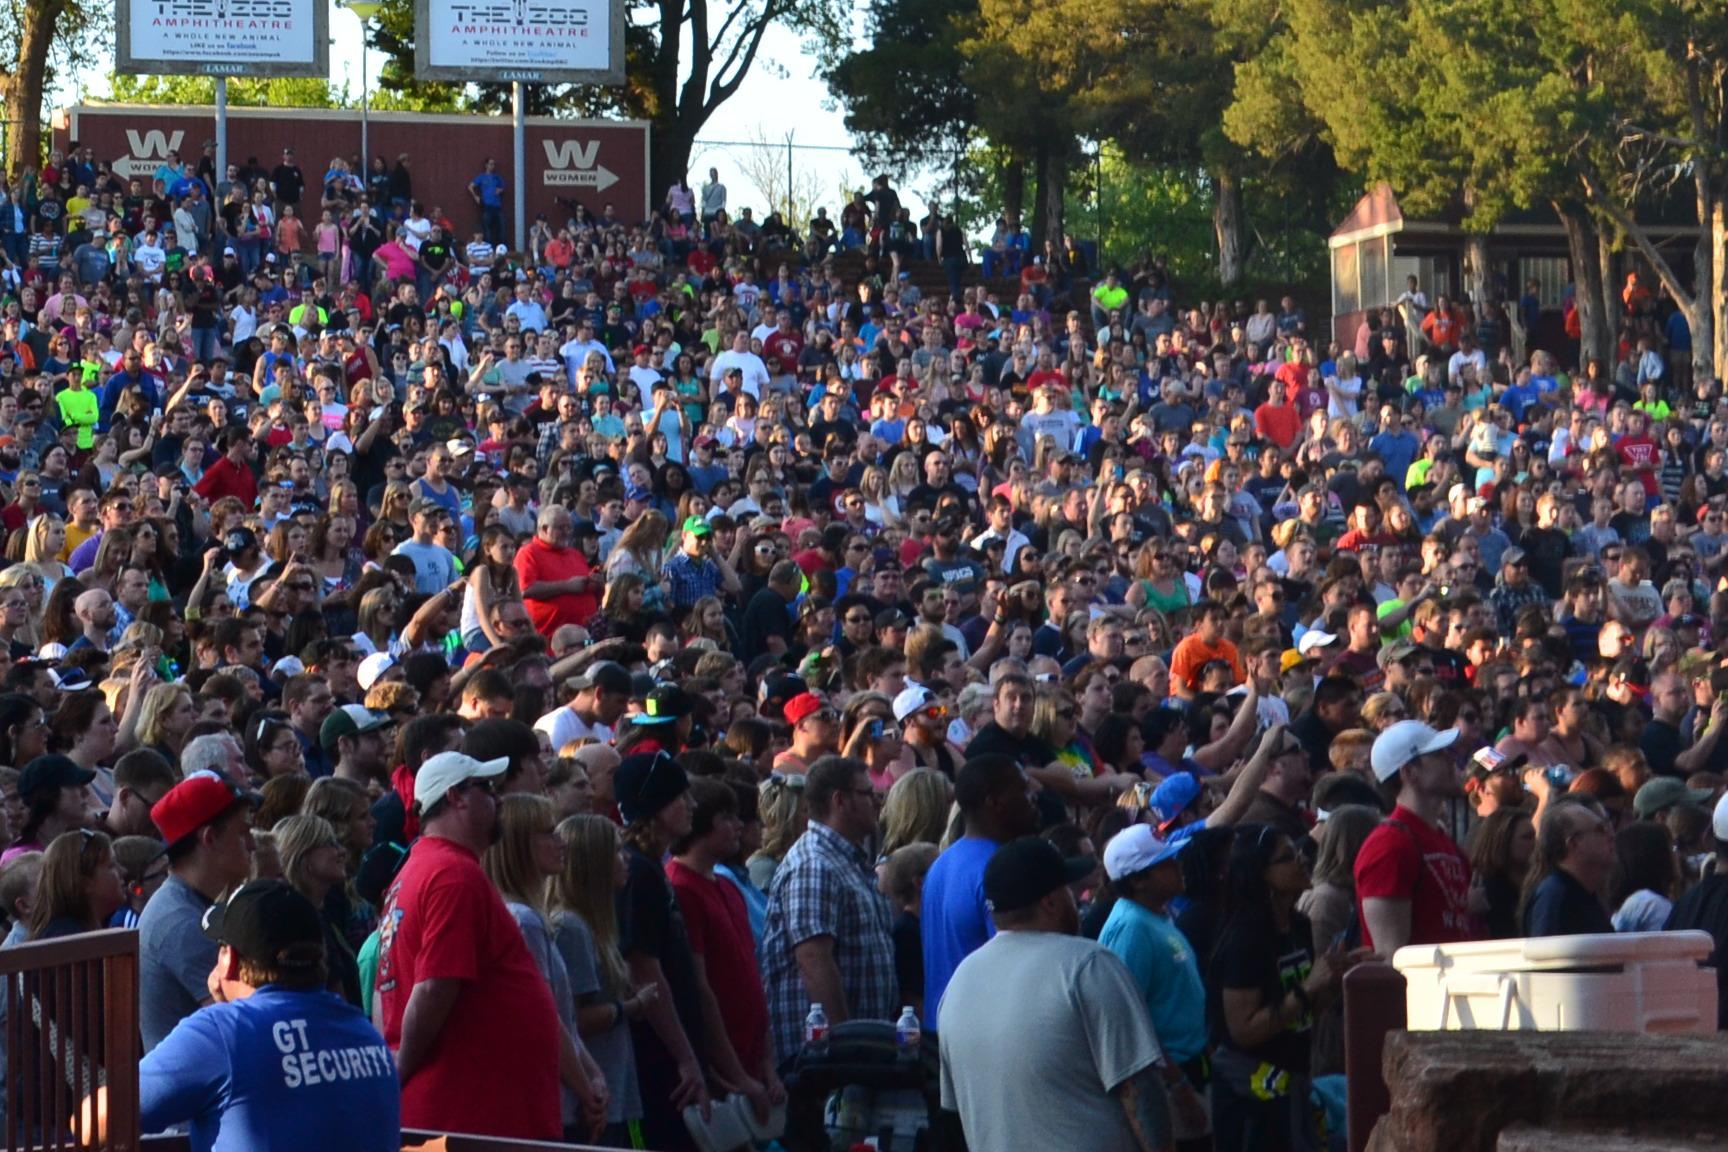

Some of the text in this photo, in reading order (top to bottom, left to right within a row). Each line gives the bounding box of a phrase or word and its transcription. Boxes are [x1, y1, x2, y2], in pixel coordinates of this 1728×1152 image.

[231, 0, 292, 18] ZOO
[451, 5, 588, 25] THE ZOO
[152, 18, 292, 30] AMPHITHEATRE
[451, 25, 588, 37] AMPHITHEATRE
[206, 64, 244, 73] LAMAR
[503, 71, 540, 79] LAMAR
[125, 129, 185, 159] W
[542, 139, 601, 169] W
[546, 174, 597, 182] WOMEN
[272, 1019, 310, 1053] GT
[281, 1045, 392, 1088] SECURITY
